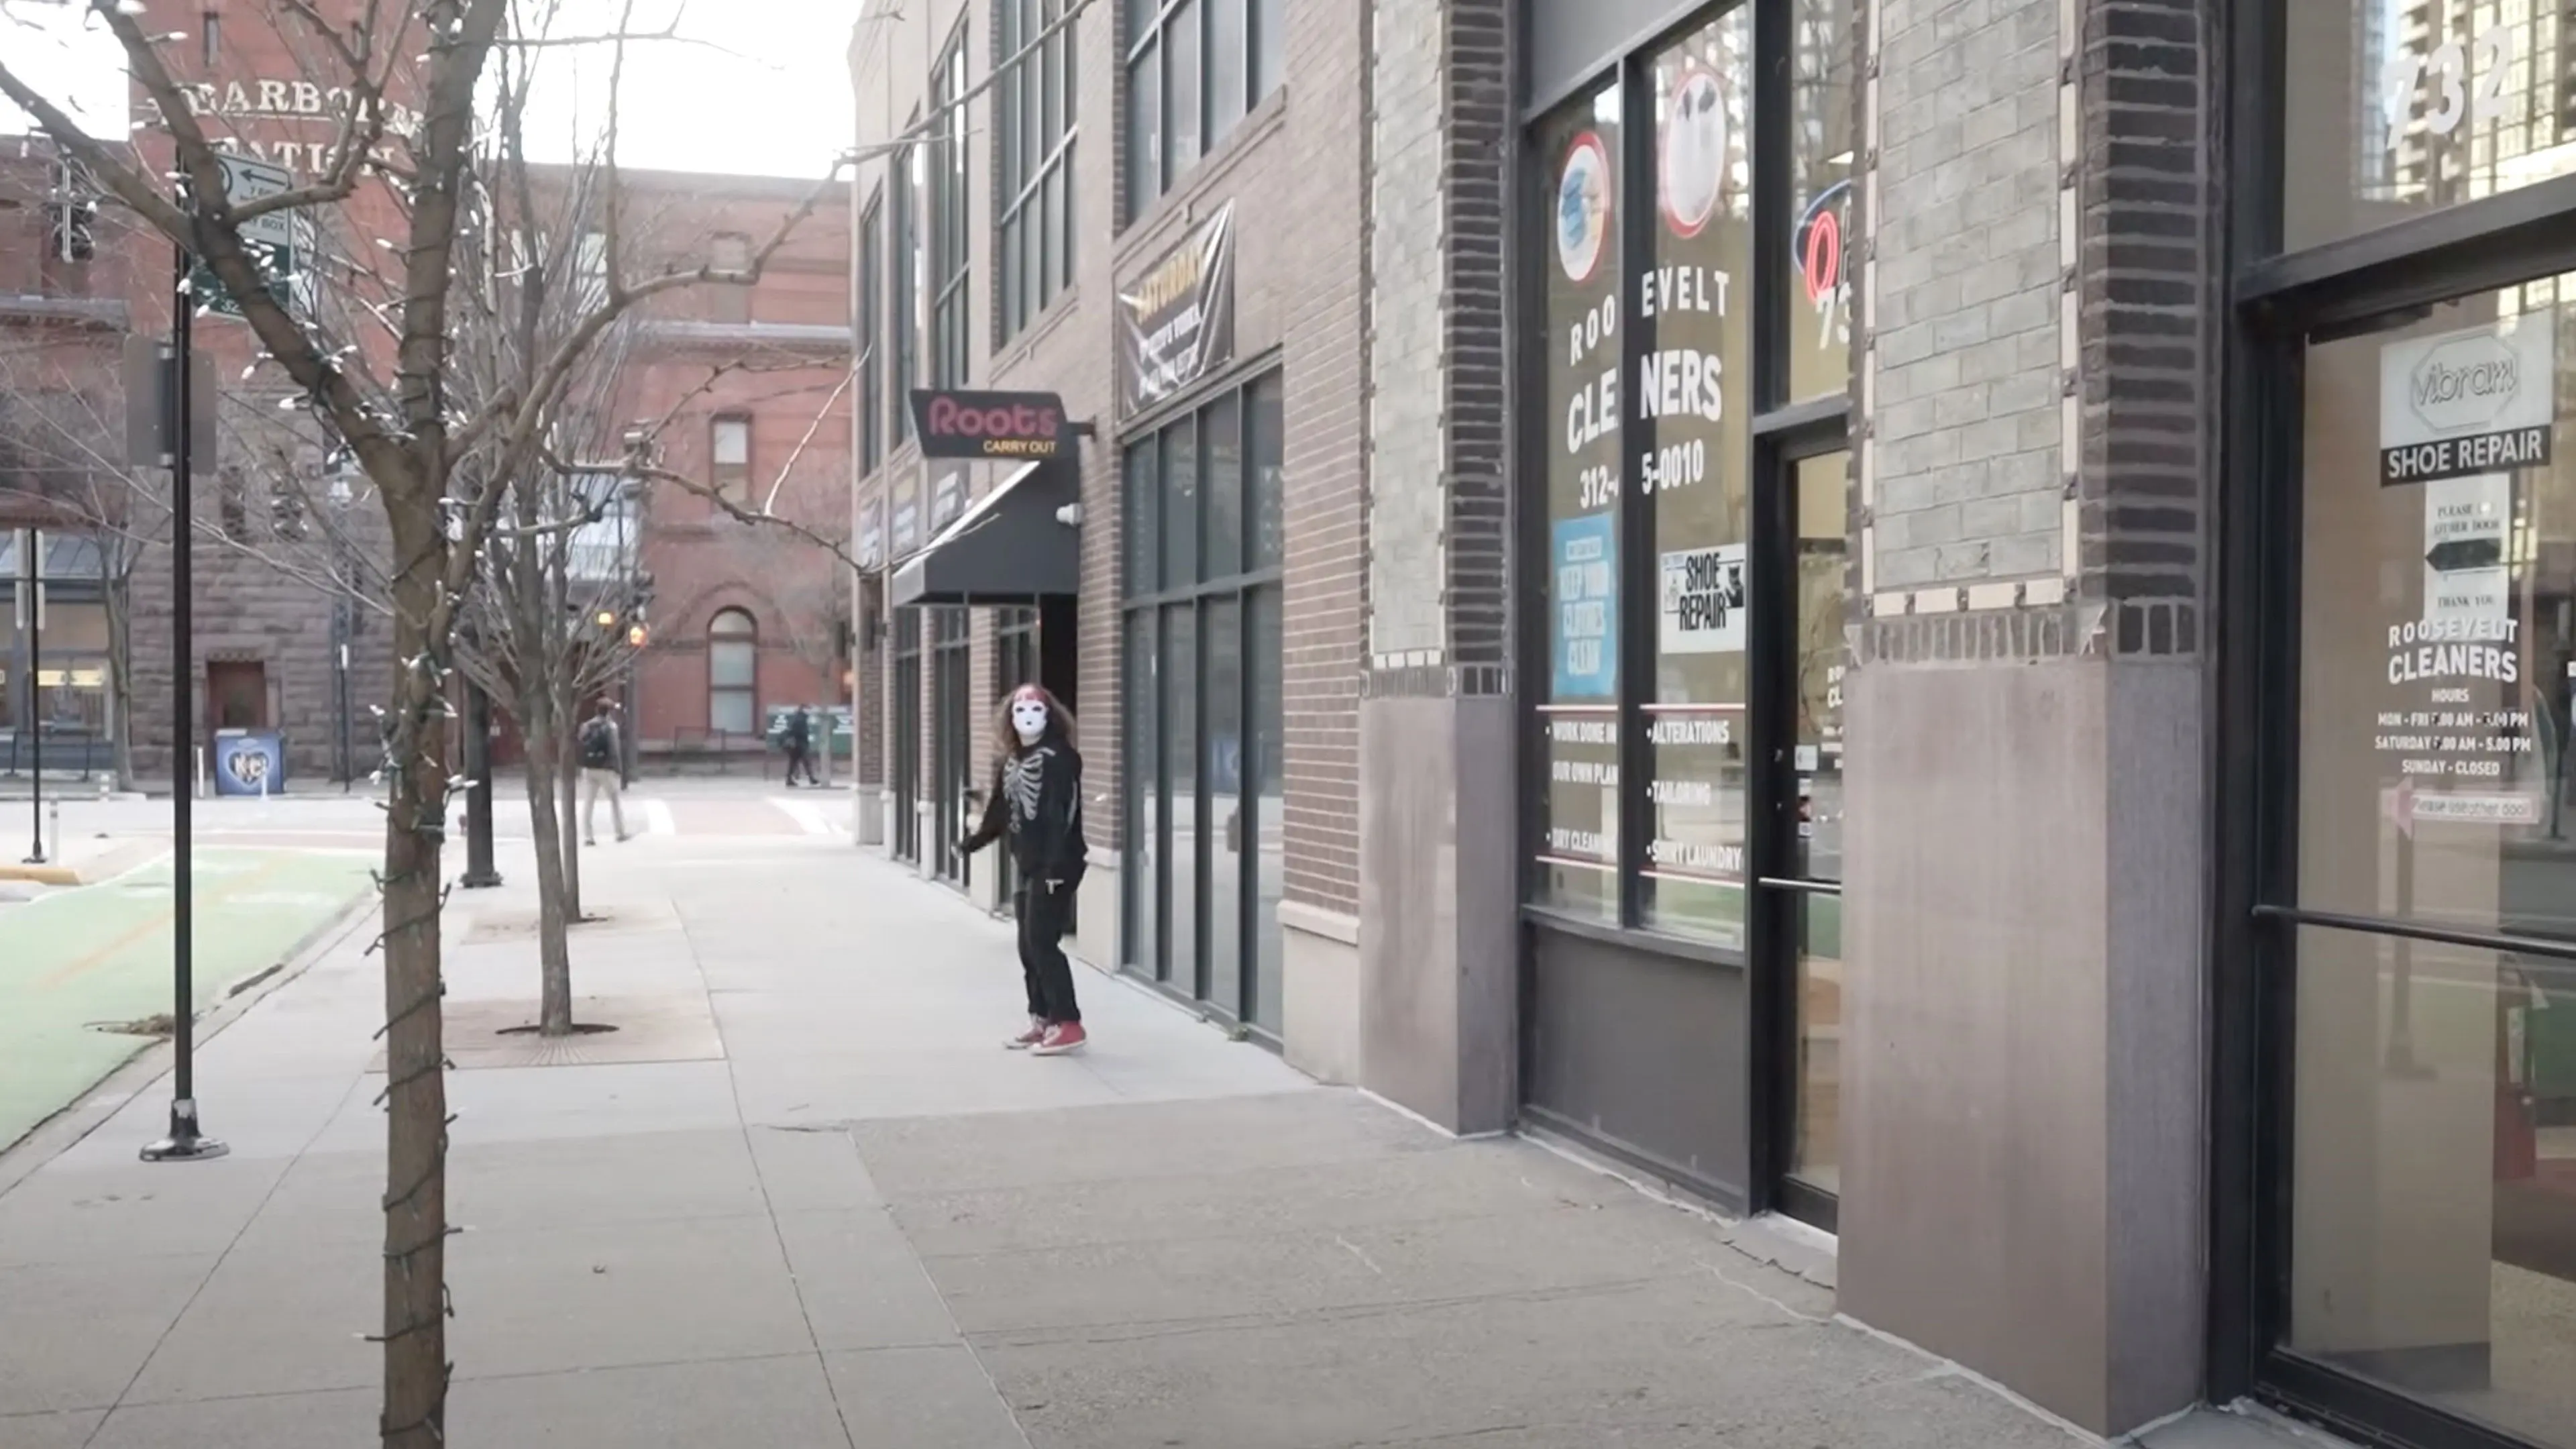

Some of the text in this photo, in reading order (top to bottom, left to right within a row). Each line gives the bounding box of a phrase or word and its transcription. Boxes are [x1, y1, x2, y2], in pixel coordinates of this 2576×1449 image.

[2381, 25, 2513, 150] 732
[1570, 266, 1729, 366] ROOEVELT
[1816, 280, 1851, 350] 73
[928, 394, 1058, 437] Roots
[1567, 349, 1722, 454] CLENERS
[983, 439, 1057, 453] CARRY OUT
[2387, 429, 2542, 479] SHOE REPAIR
[1579, 438, 1705, 508] 312-5-0010
[1684, 551, 1721, 592] SHOE
[1678, 592, 1727, 631] REPAIR
[2389, 618, 2518, 649] ROOSEVELT
[2389, 644, 2517, 686] CLEANERS
[2431, 688, 2470, 703] HOURS
[1652, 720, 1729, 745] ALTERATIONS
[2455, 712, 2473, 727] AM
[2510, 712, 2529, 727] PM
[2375, 736, 2432, 751] SATURDAY
[2457, 737, 2476, 751] AM
[2512, 737, 2532, 752] PM
[2402, 759, 2447, 774] SUNDAY
[2455, 761, 2501, 775] CLOSED
[1686, 843, 1743, 871] LAUNDRY
